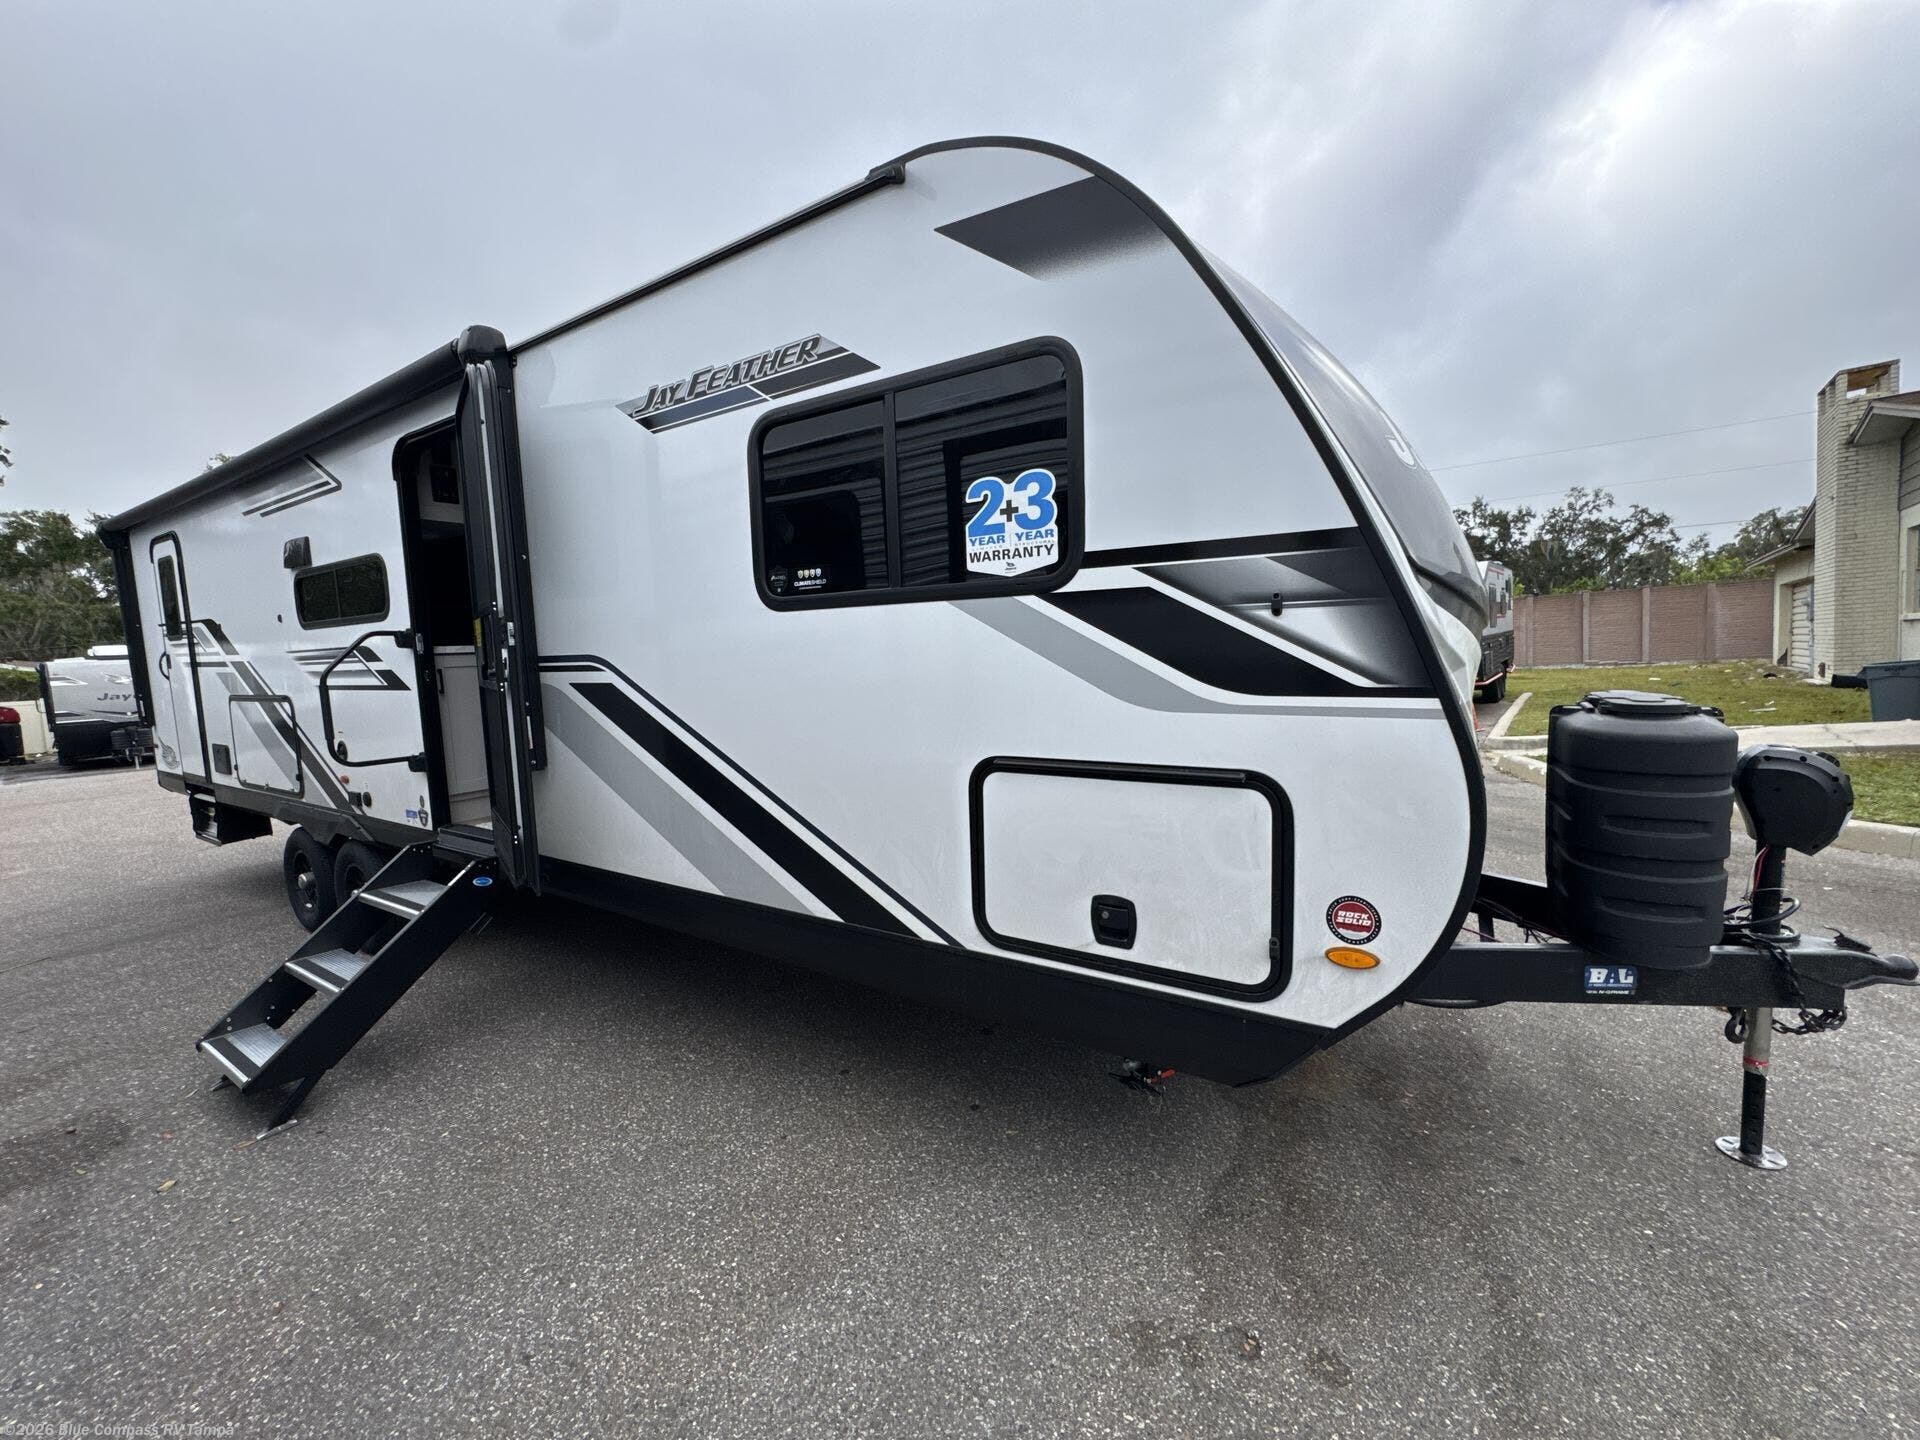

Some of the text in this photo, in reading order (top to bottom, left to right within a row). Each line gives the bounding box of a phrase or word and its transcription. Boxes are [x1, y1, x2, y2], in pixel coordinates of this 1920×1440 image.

[685, 333, 822, 400] FEATHER
[969, 535, 1006, 547] YEAR
[1015, 529, 1055, 542] YEAR
[969, 544, 1055, 564] WARRANTY
[1337, 910, 1370, 920] ROCK
[1335, 916, 1372, 927] SOLID
